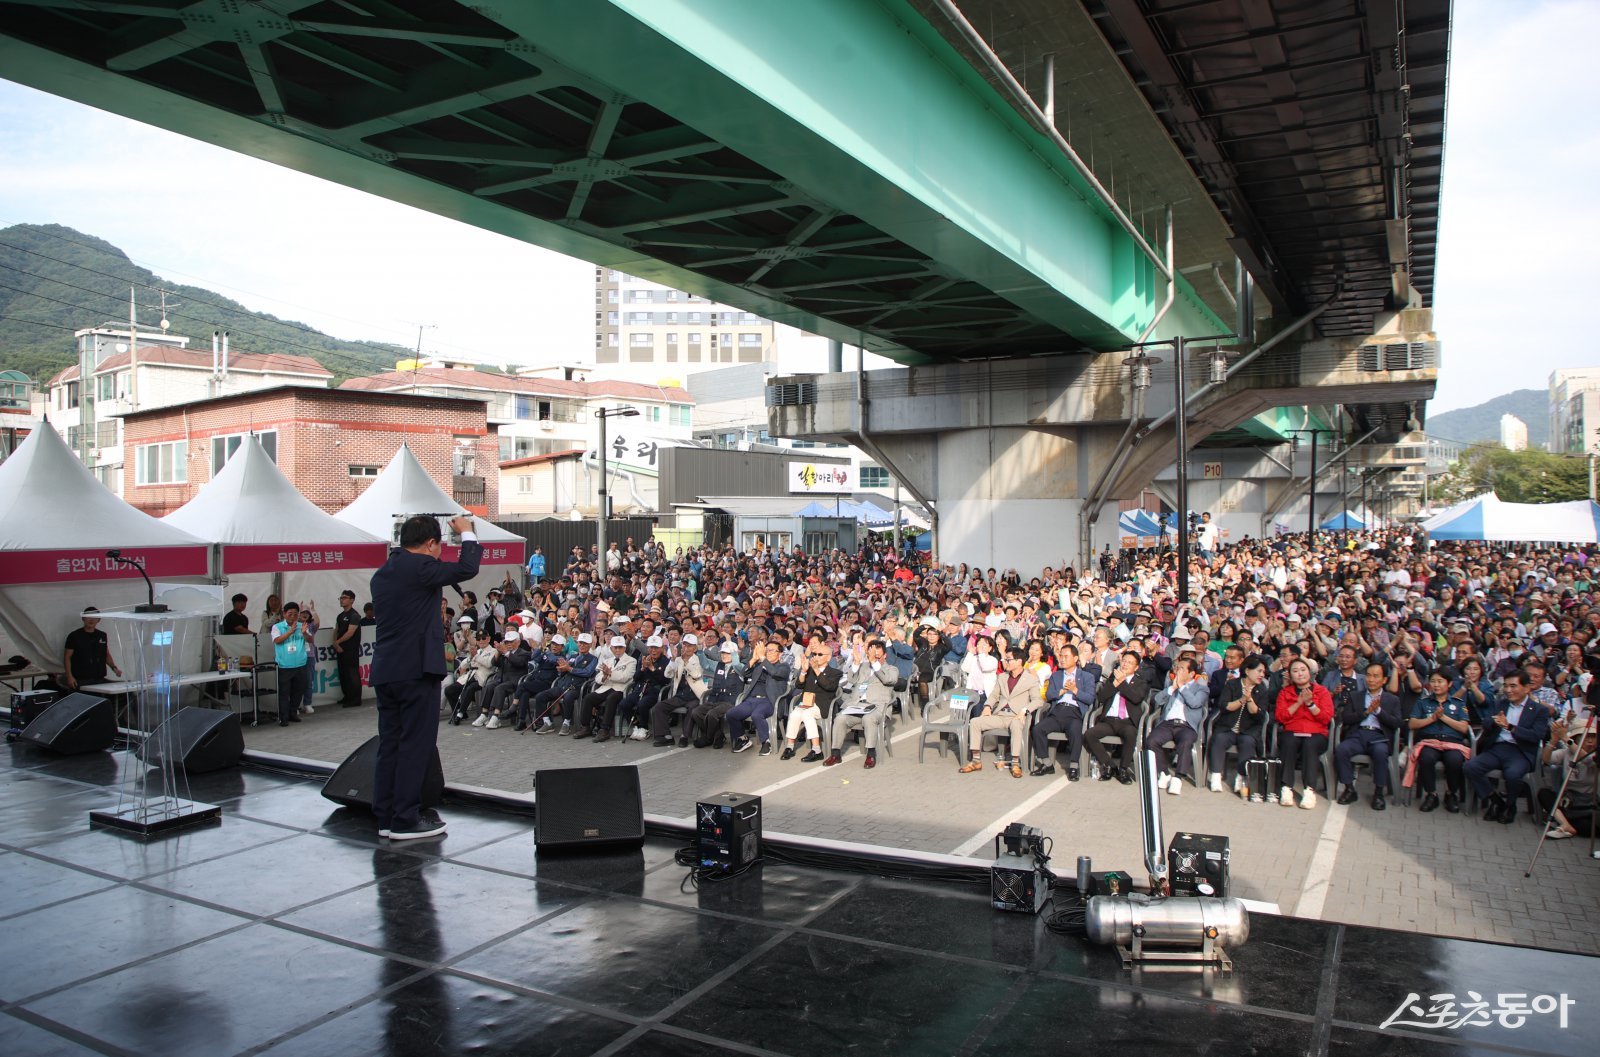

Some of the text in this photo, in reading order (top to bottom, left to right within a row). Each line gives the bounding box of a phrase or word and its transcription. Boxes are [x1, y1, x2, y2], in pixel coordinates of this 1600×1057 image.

[1204, 464, 1221, 476] P10
[278, 551, 344, 564] 무대 운영 본부
[493, 549, 507, 559] 본부
[56, 556, 146, 573] 출연자 대기실
